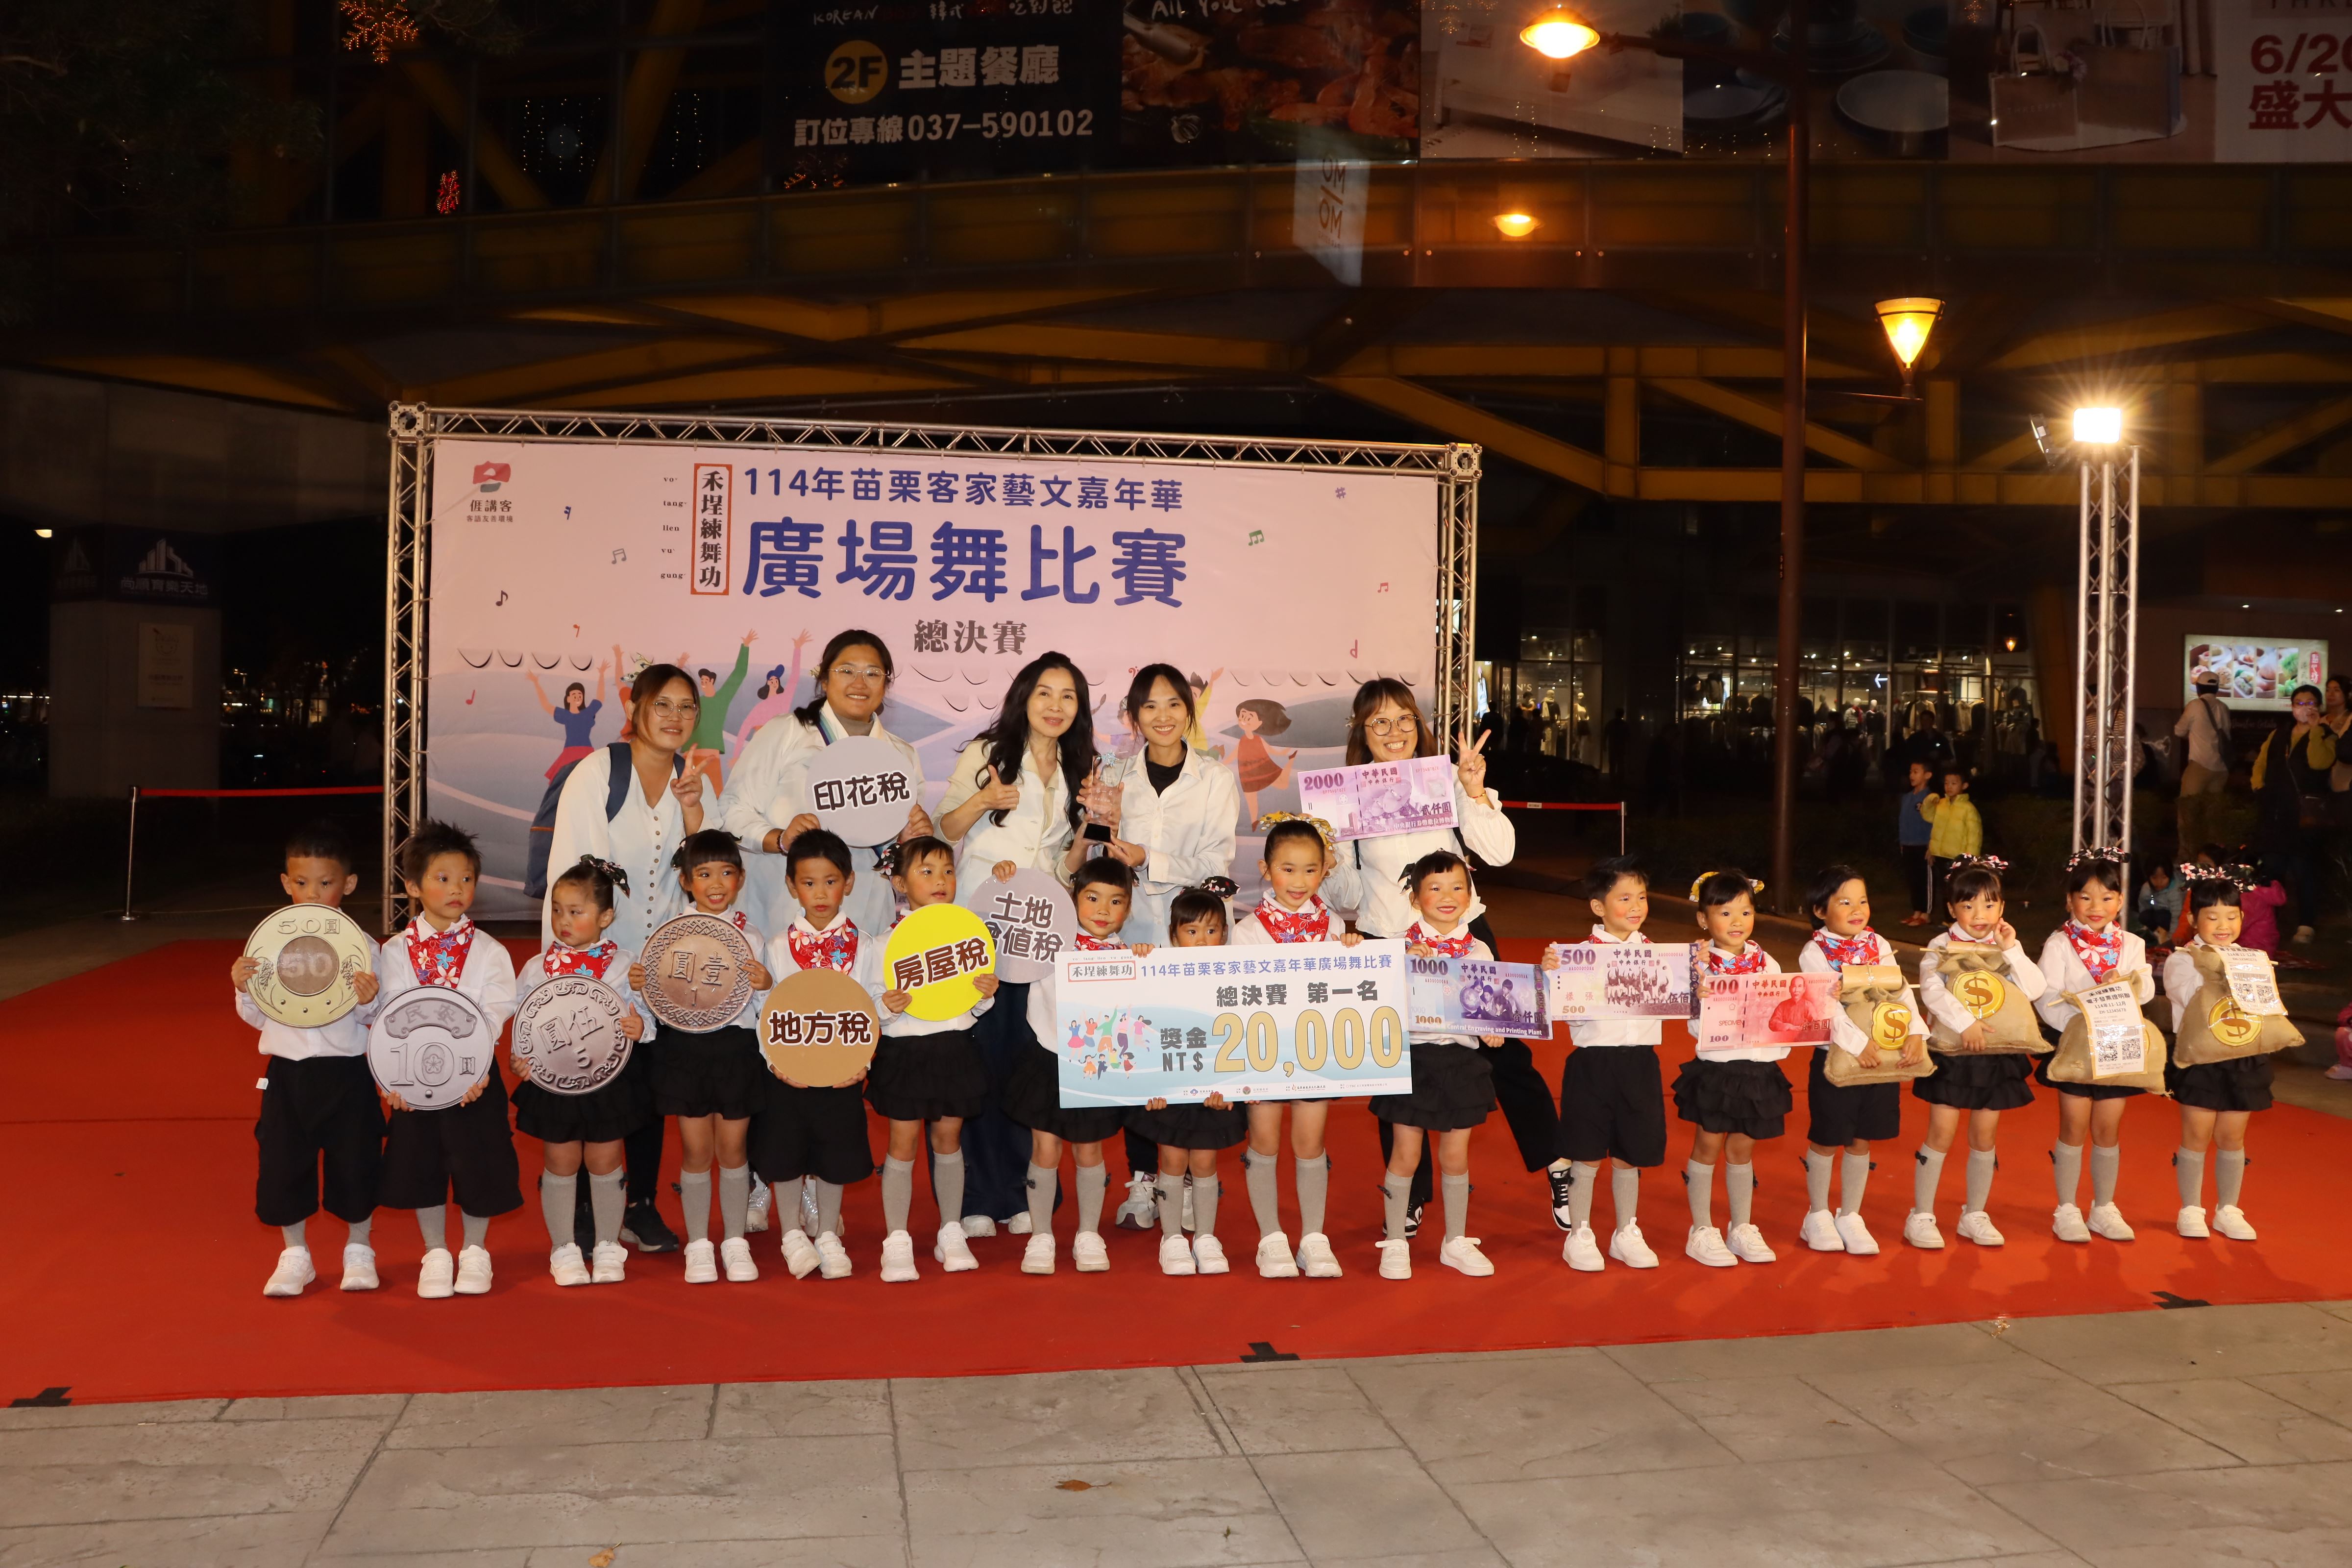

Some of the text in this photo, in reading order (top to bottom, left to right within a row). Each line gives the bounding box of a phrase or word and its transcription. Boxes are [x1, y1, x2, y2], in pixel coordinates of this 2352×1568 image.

[813, 5, 879, 25] KOREAN
[831, 56, 882, 90] 2F
[899, 45, 1060, 89] 主題餐廳
[2249, 79, 2352, 129] 盛大
[744, 466, 1183, 512] 114年苗栗客家藝文嘉年華
[699, 470, 724, 588] 禾埕練舞功
[742, 516, 1186, 608] 廣場舞比賽
[914, 619, 1028, 655] 總決賽
[1502, 683, 1532, 692] MN'S
[1304, 773, 1344, 791] 2000
[1362, 767, 1397, 779] 中華民國
[814, 772, 910, 810] 印花稅
[1421, 802, 1451, 816] 貳仟圓
[991, 892, 1053, 928] 土地
[277, 917, 341, 935] 50圓
[893, 938, 989, 990] 房屋稅
[1561, 949, 1596, 965] 500
[1613, 949, 1652, 958] 中華民國
[1072, 964, 1132, 978] 禾埕練舞功
[1141, 954, 1393, 978] 114年苗栗客家藝文嘉年華廣場舞比賽
[1410, 958, 1448, 976] 1000
[1461, 963, 1497, 975] 中華民國
[1216, 980, 1378, 1007] 總決賽 第一名
[1709, 979, 1739, 995] 100
[1752, 980, 1787, 989] 中華民國
[1562, 1005, 1586, 1014] 500
[2086, 993, 2131, 1004] 電子發票證明聯
[769, 1011, 872, 1045] 地方稅
[1468, 1025, 1494, 1033] Engraving
[1506, 1027, 1527, 1035] Printing
[1883, 1007, 1907, 1043] $
[1160, 1027, 1208, 1050] 獎金
[1211, 1006, 1403, 1078] 20,000
[1162, 1051, 1203, 1073] NT$
